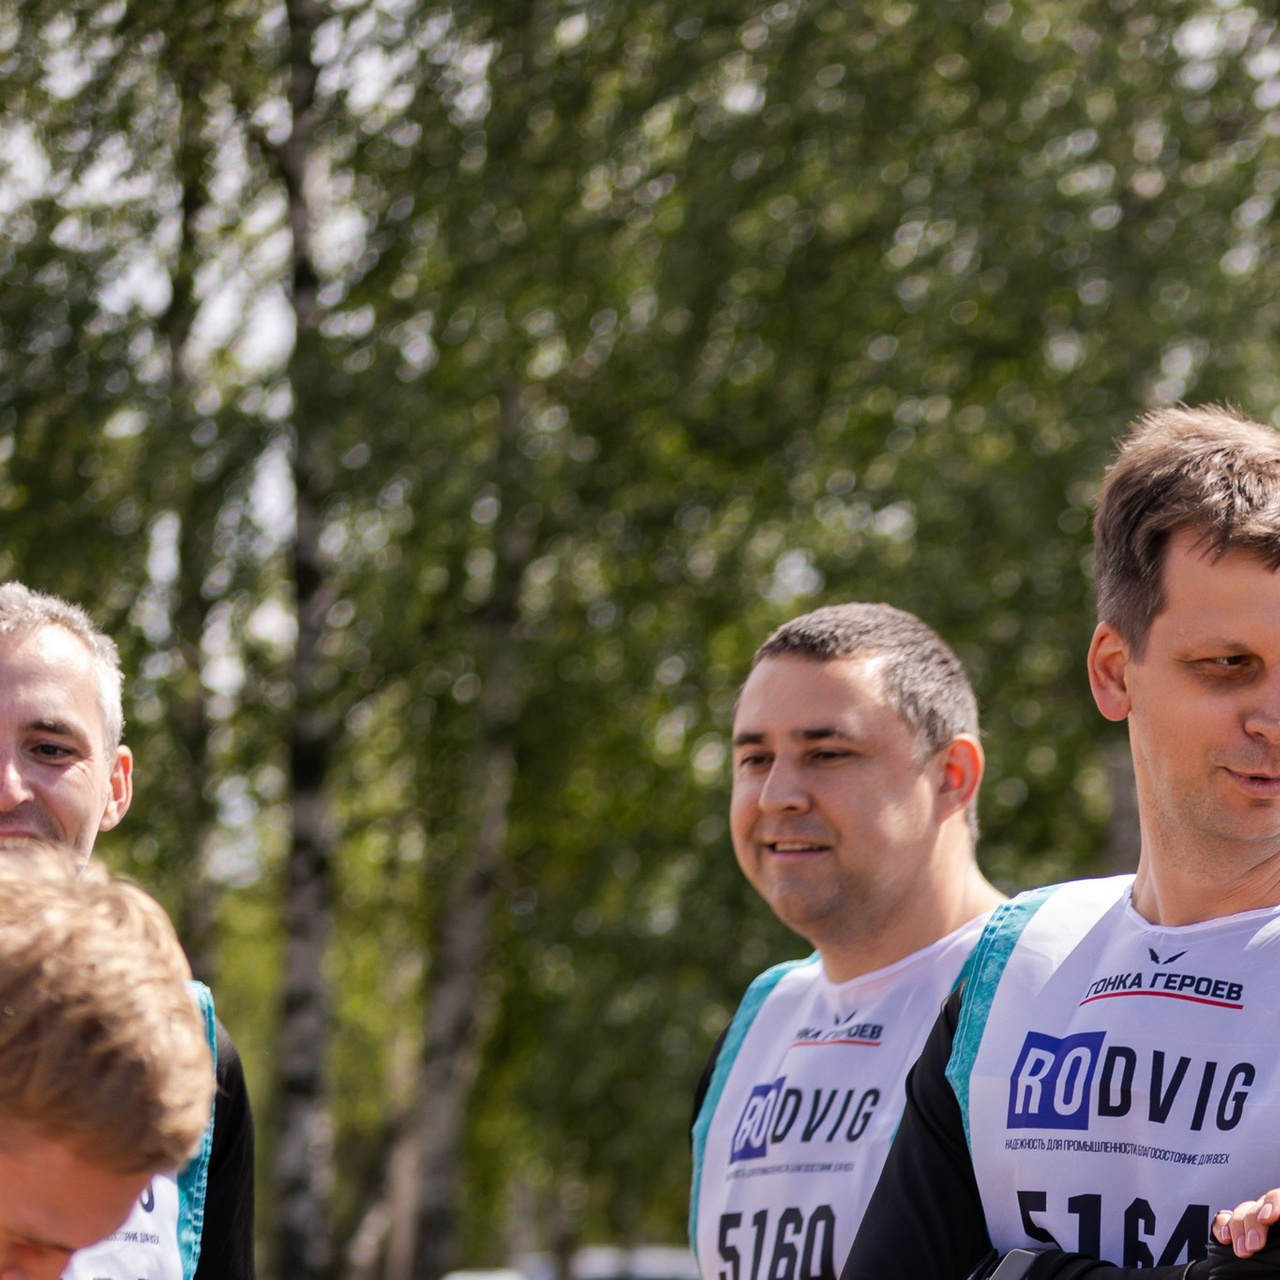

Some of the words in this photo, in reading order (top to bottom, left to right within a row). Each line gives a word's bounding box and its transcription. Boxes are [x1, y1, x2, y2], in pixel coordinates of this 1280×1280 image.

[1086, 973, 1142, 999] ГОНКА
[1150, 973, 1244, 1001] ГЕРОЕВ
[733, 1087, 881, 1153] RODVIG
[1015, 1046, 1256, 1131] RODVIG
[1005, 1138, 1046, 1151] НАДЕЖНОСТЬ
[1046, 1139, 1063, 1151] ДЛЯ
[1197, 1154, 1212, 1166] ДЛЯ
[1212, 1153, 1230, 1165] ВСЕХ
[1017, 1190, 1210, 1268] 5164
